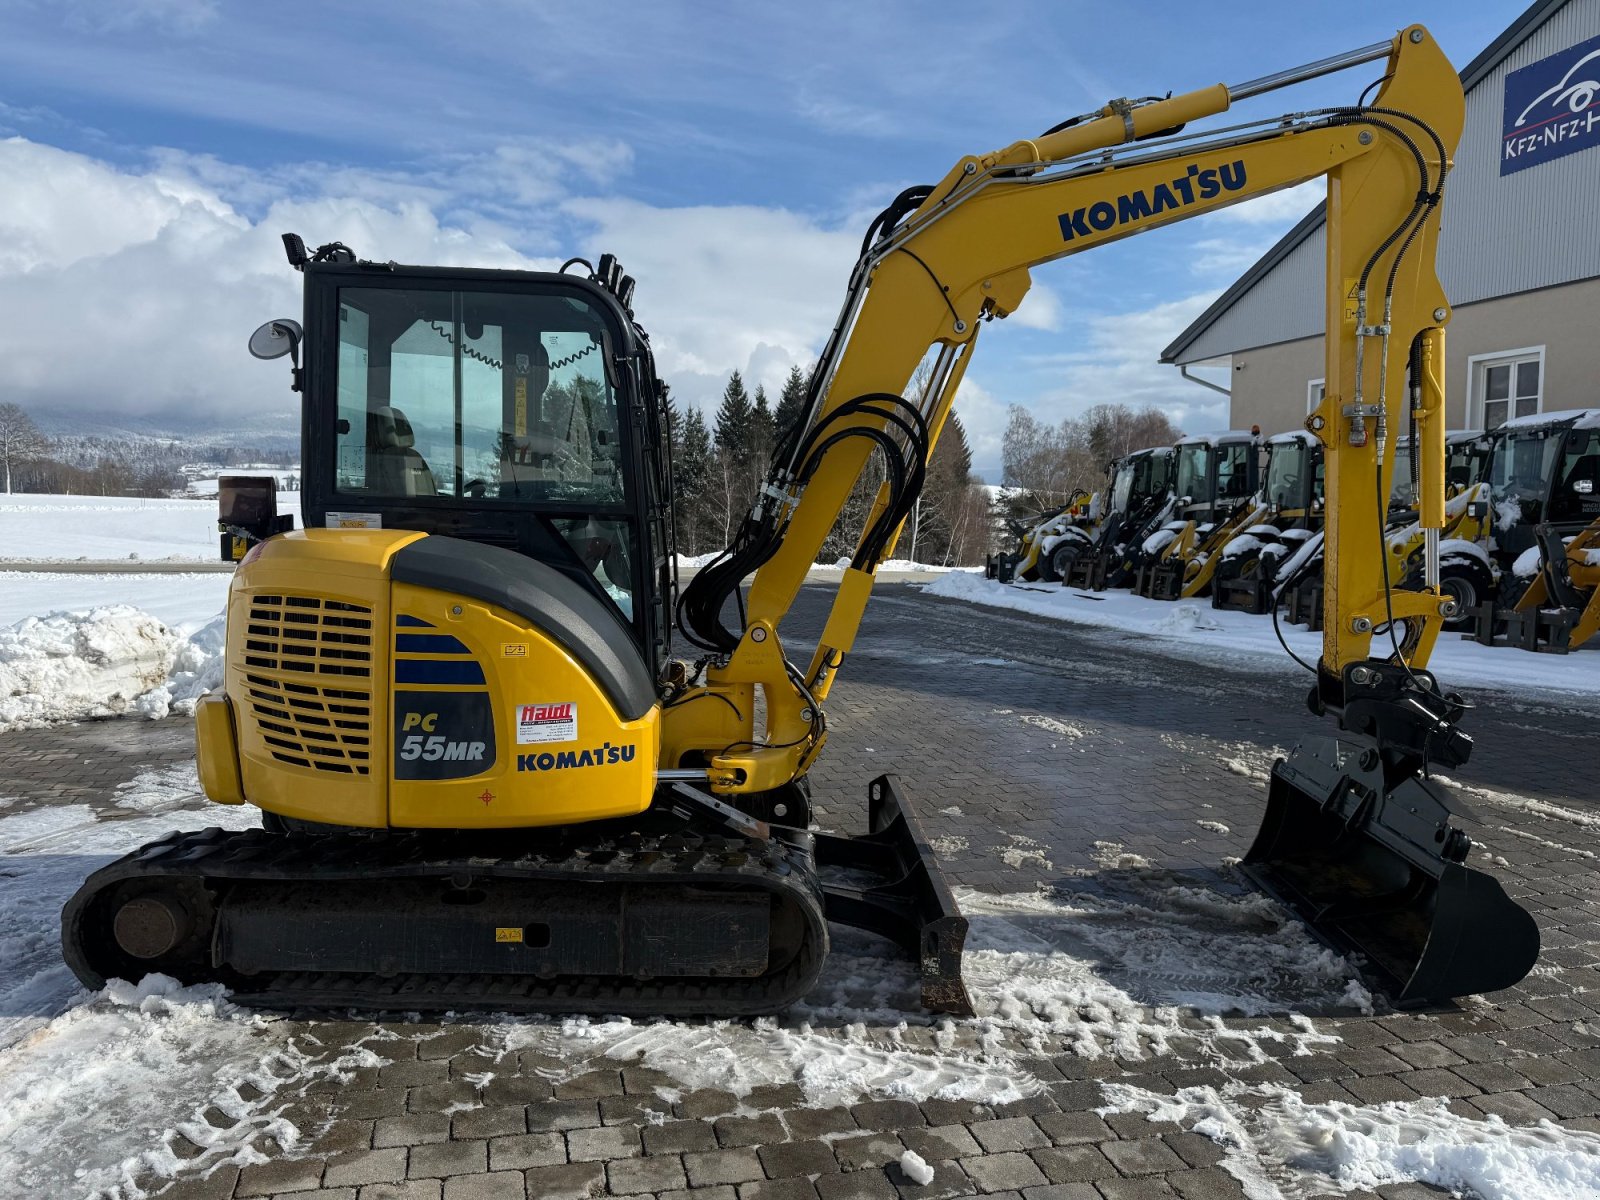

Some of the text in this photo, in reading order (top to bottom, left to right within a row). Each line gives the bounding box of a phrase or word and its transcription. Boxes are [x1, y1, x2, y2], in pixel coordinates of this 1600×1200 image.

[1058, 160, 1247, 241] KOMATSU
[402, 713, 438, 732] PC
[521, 704, 572, 721] Haidl
[400, 736, 485, 761] 55MR
[517, 742, 635, 772] KOMATSU
